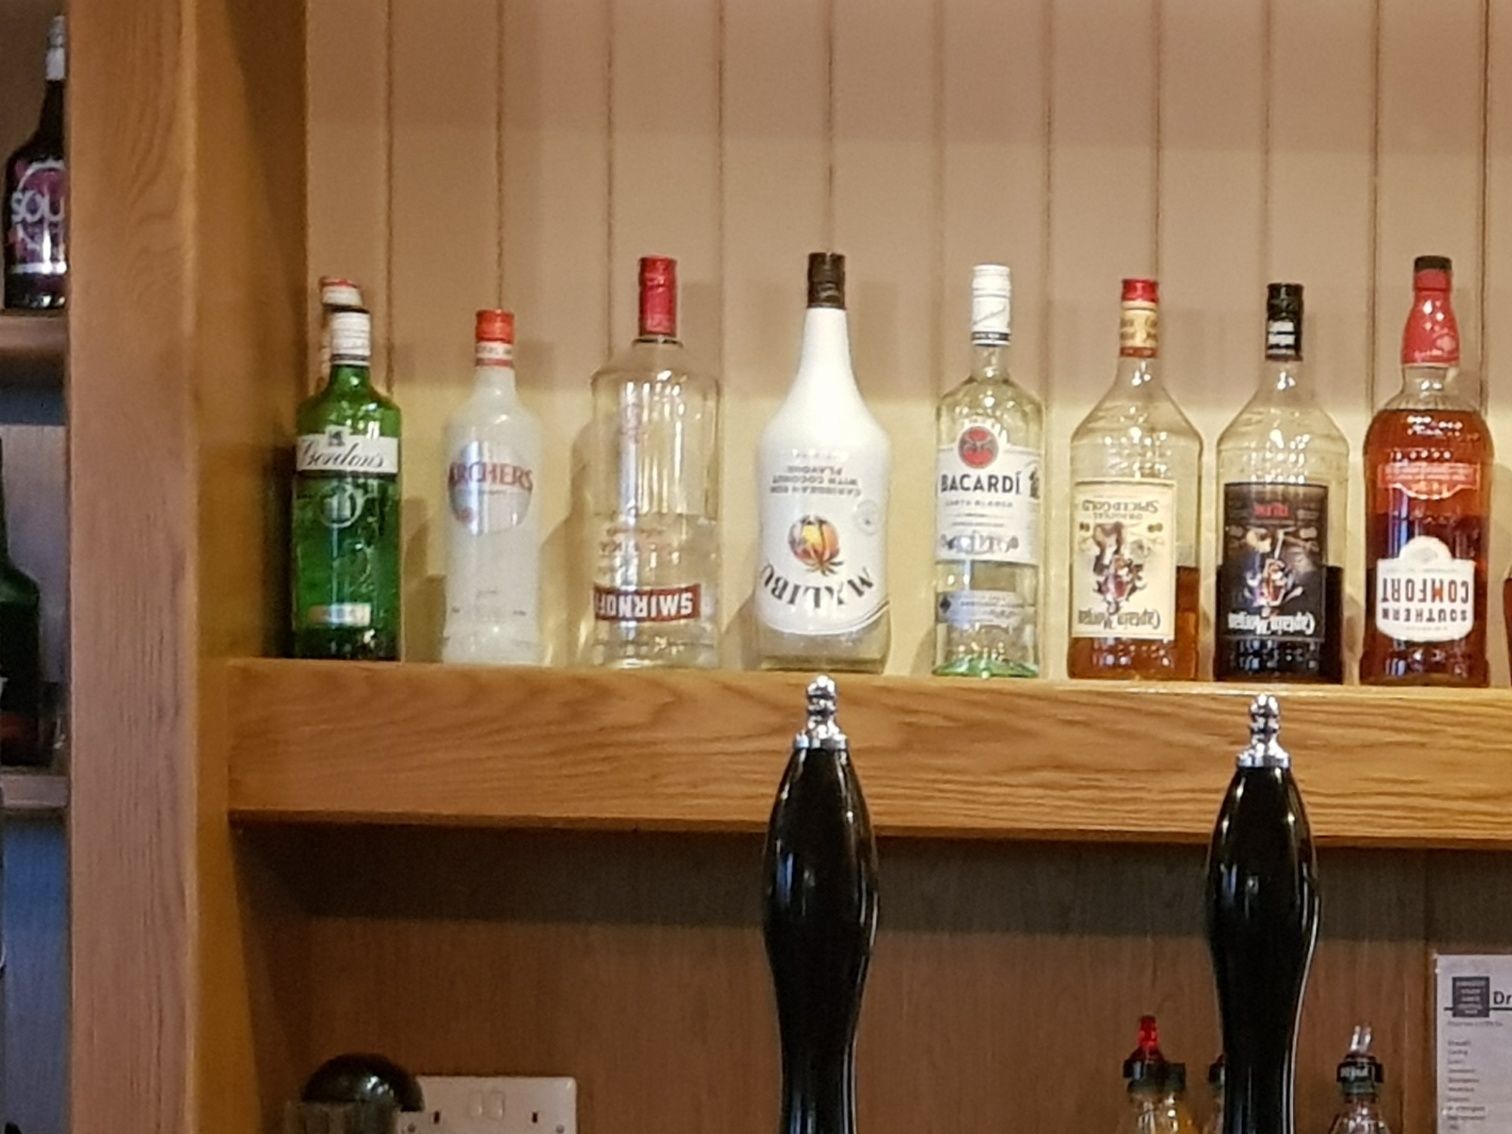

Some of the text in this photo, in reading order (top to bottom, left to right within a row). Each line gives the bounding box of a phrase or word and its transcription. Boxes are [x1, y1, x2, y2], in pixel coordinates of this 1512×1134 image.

[449, 461, 534, 491] ARCHERS
[761, 563, 875, 609] MALIBU
[1381, 578, 1469, 604] COMFORT
[1382, 607, 1468, 623] SOUTHERN
